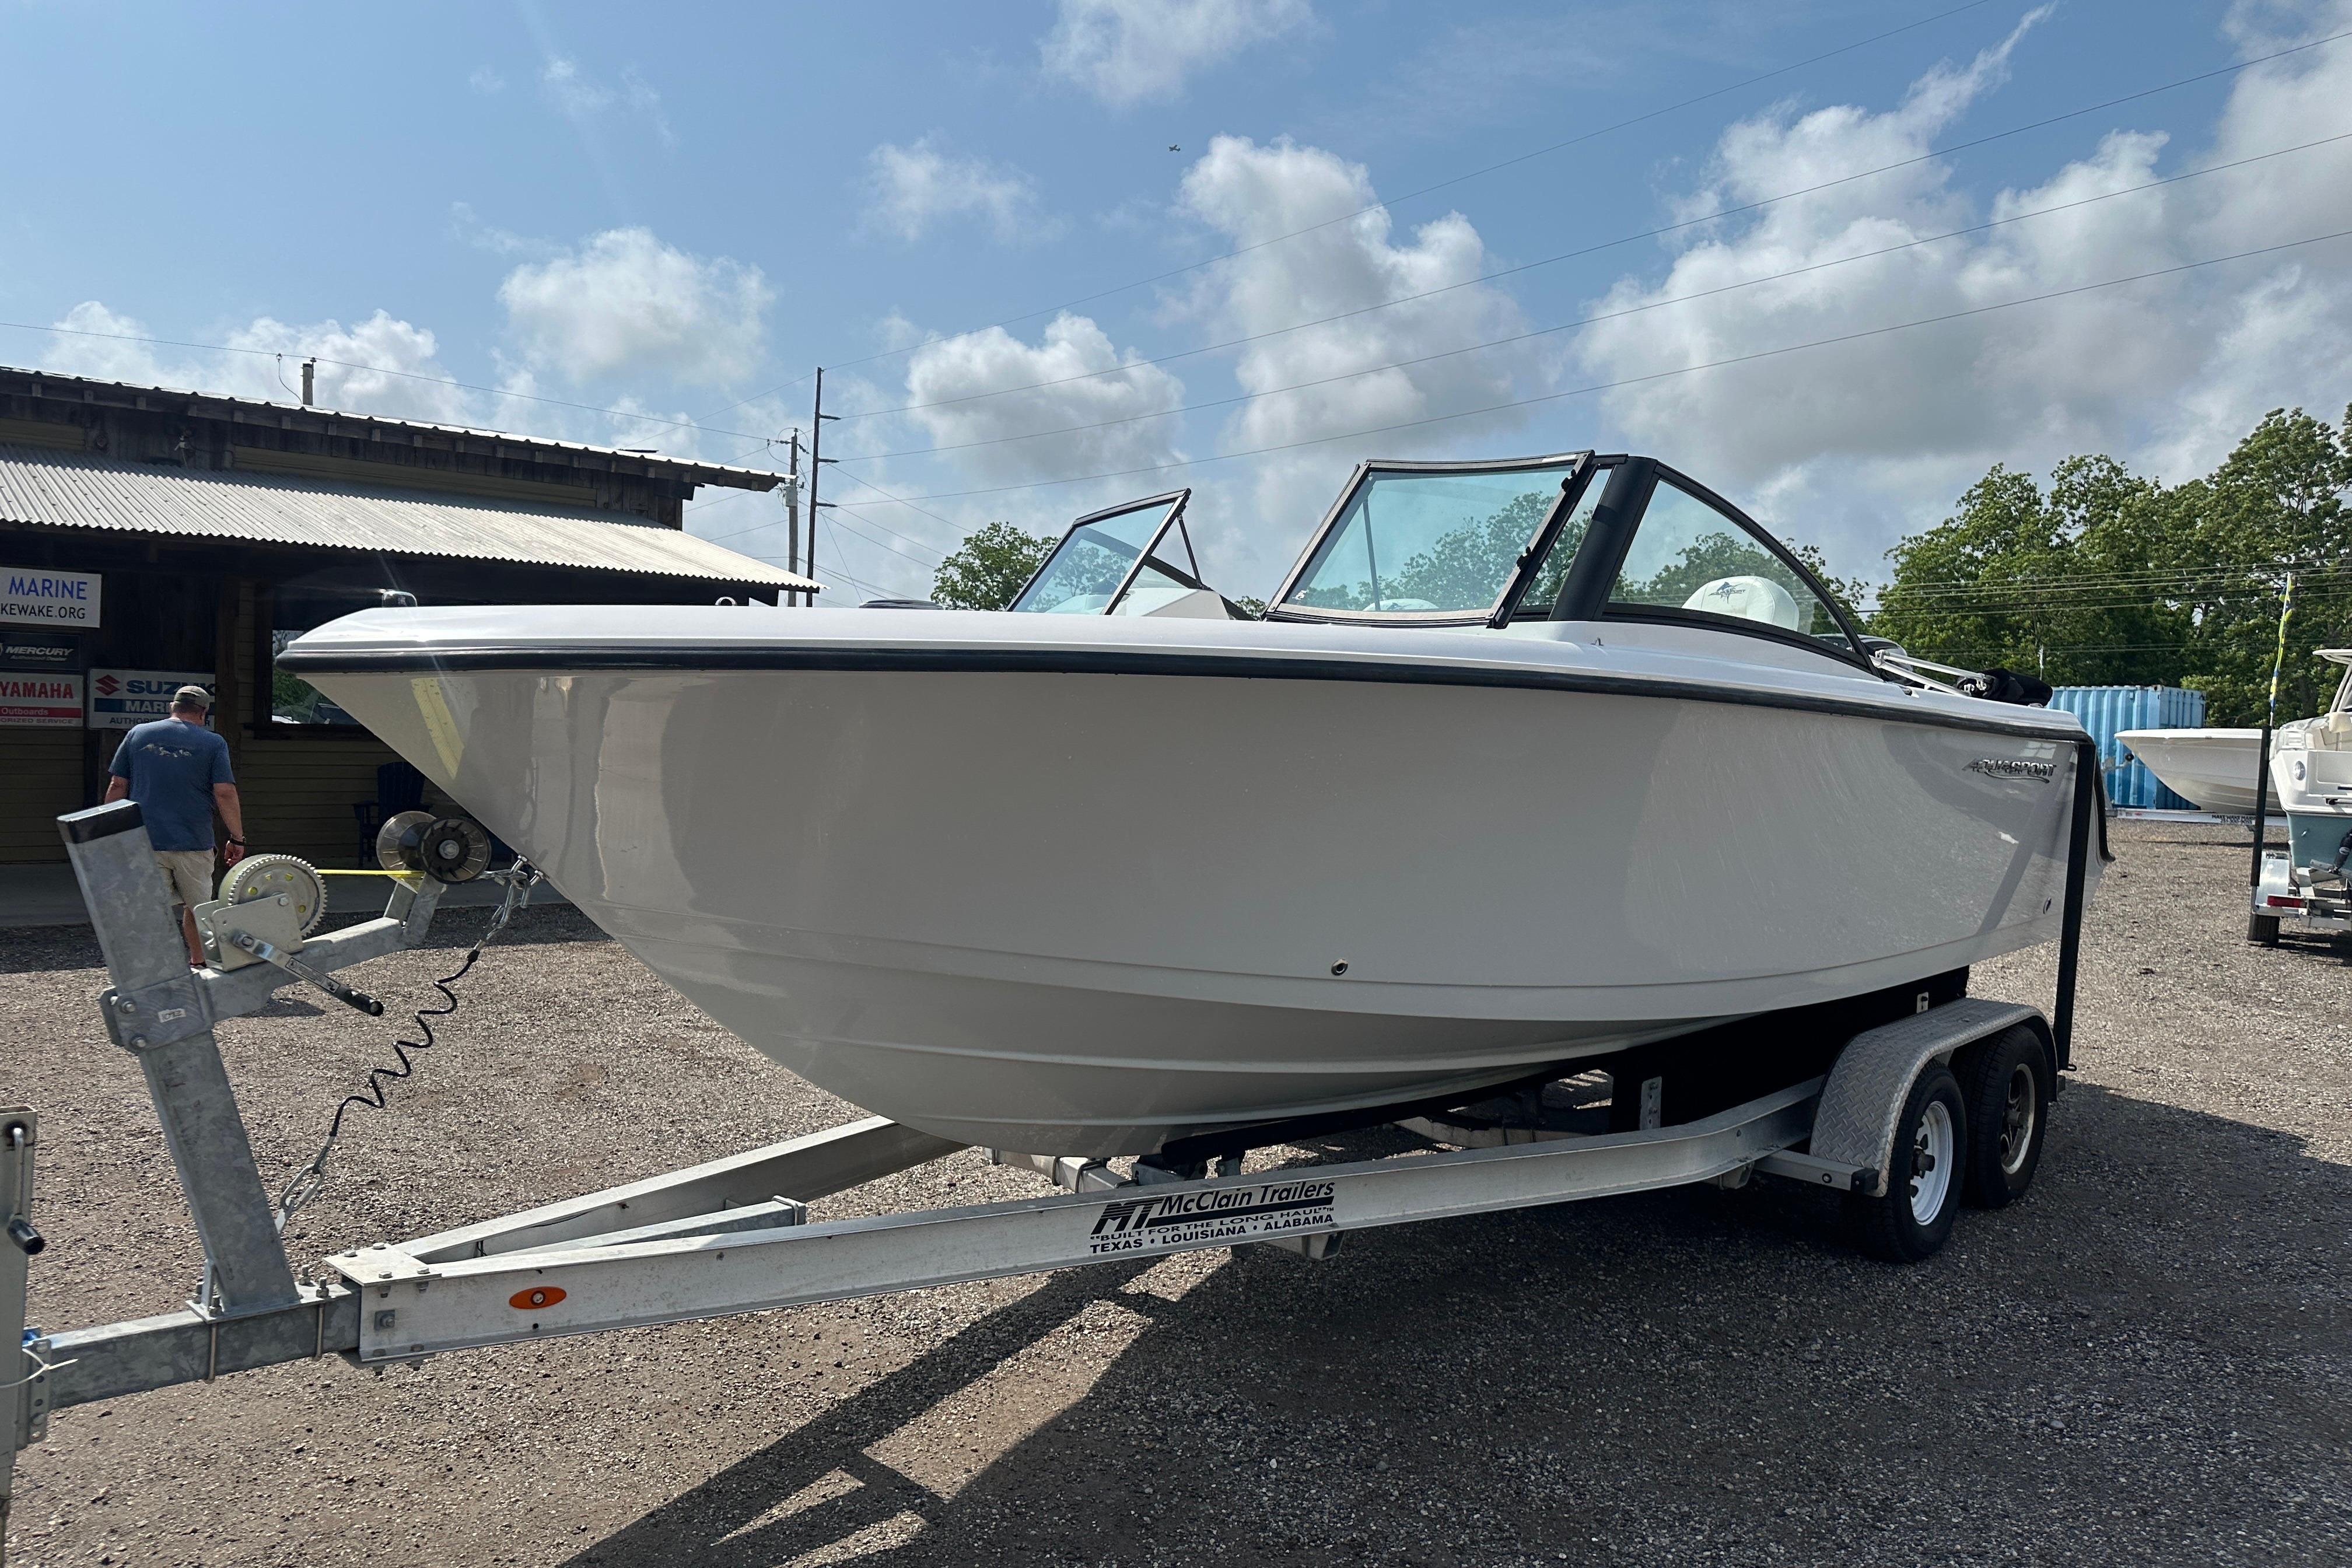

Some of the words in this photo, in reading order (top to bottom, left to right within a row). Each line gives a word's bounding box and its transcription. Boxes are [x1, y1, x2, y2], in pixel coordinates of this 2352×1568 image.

[9, 576, 88, 600] MARINE
[1, 603, 86, 619] KEWAKE.ORG
[5, 646, 74, 656] MERCURY
[0, 681, 74, 699] YAMAHA
[1, 707, 48, 716] Outboards
[1158, 1189, 1252, 1216] McClain
[1259, 1182, 1335, 1204] Trailers
[1090, 1238, 1143, 1254] TEXAS
[1162, 1226, 1247, 1244] LOUISIANA
[1264, 1214, 1334, 1231] ALABAMA
[1148, 1226, 1181, 1236] FOR
[1184, 1221, 1214, 1230] THE
[1220, 1214, 1274, 1226] LONG
